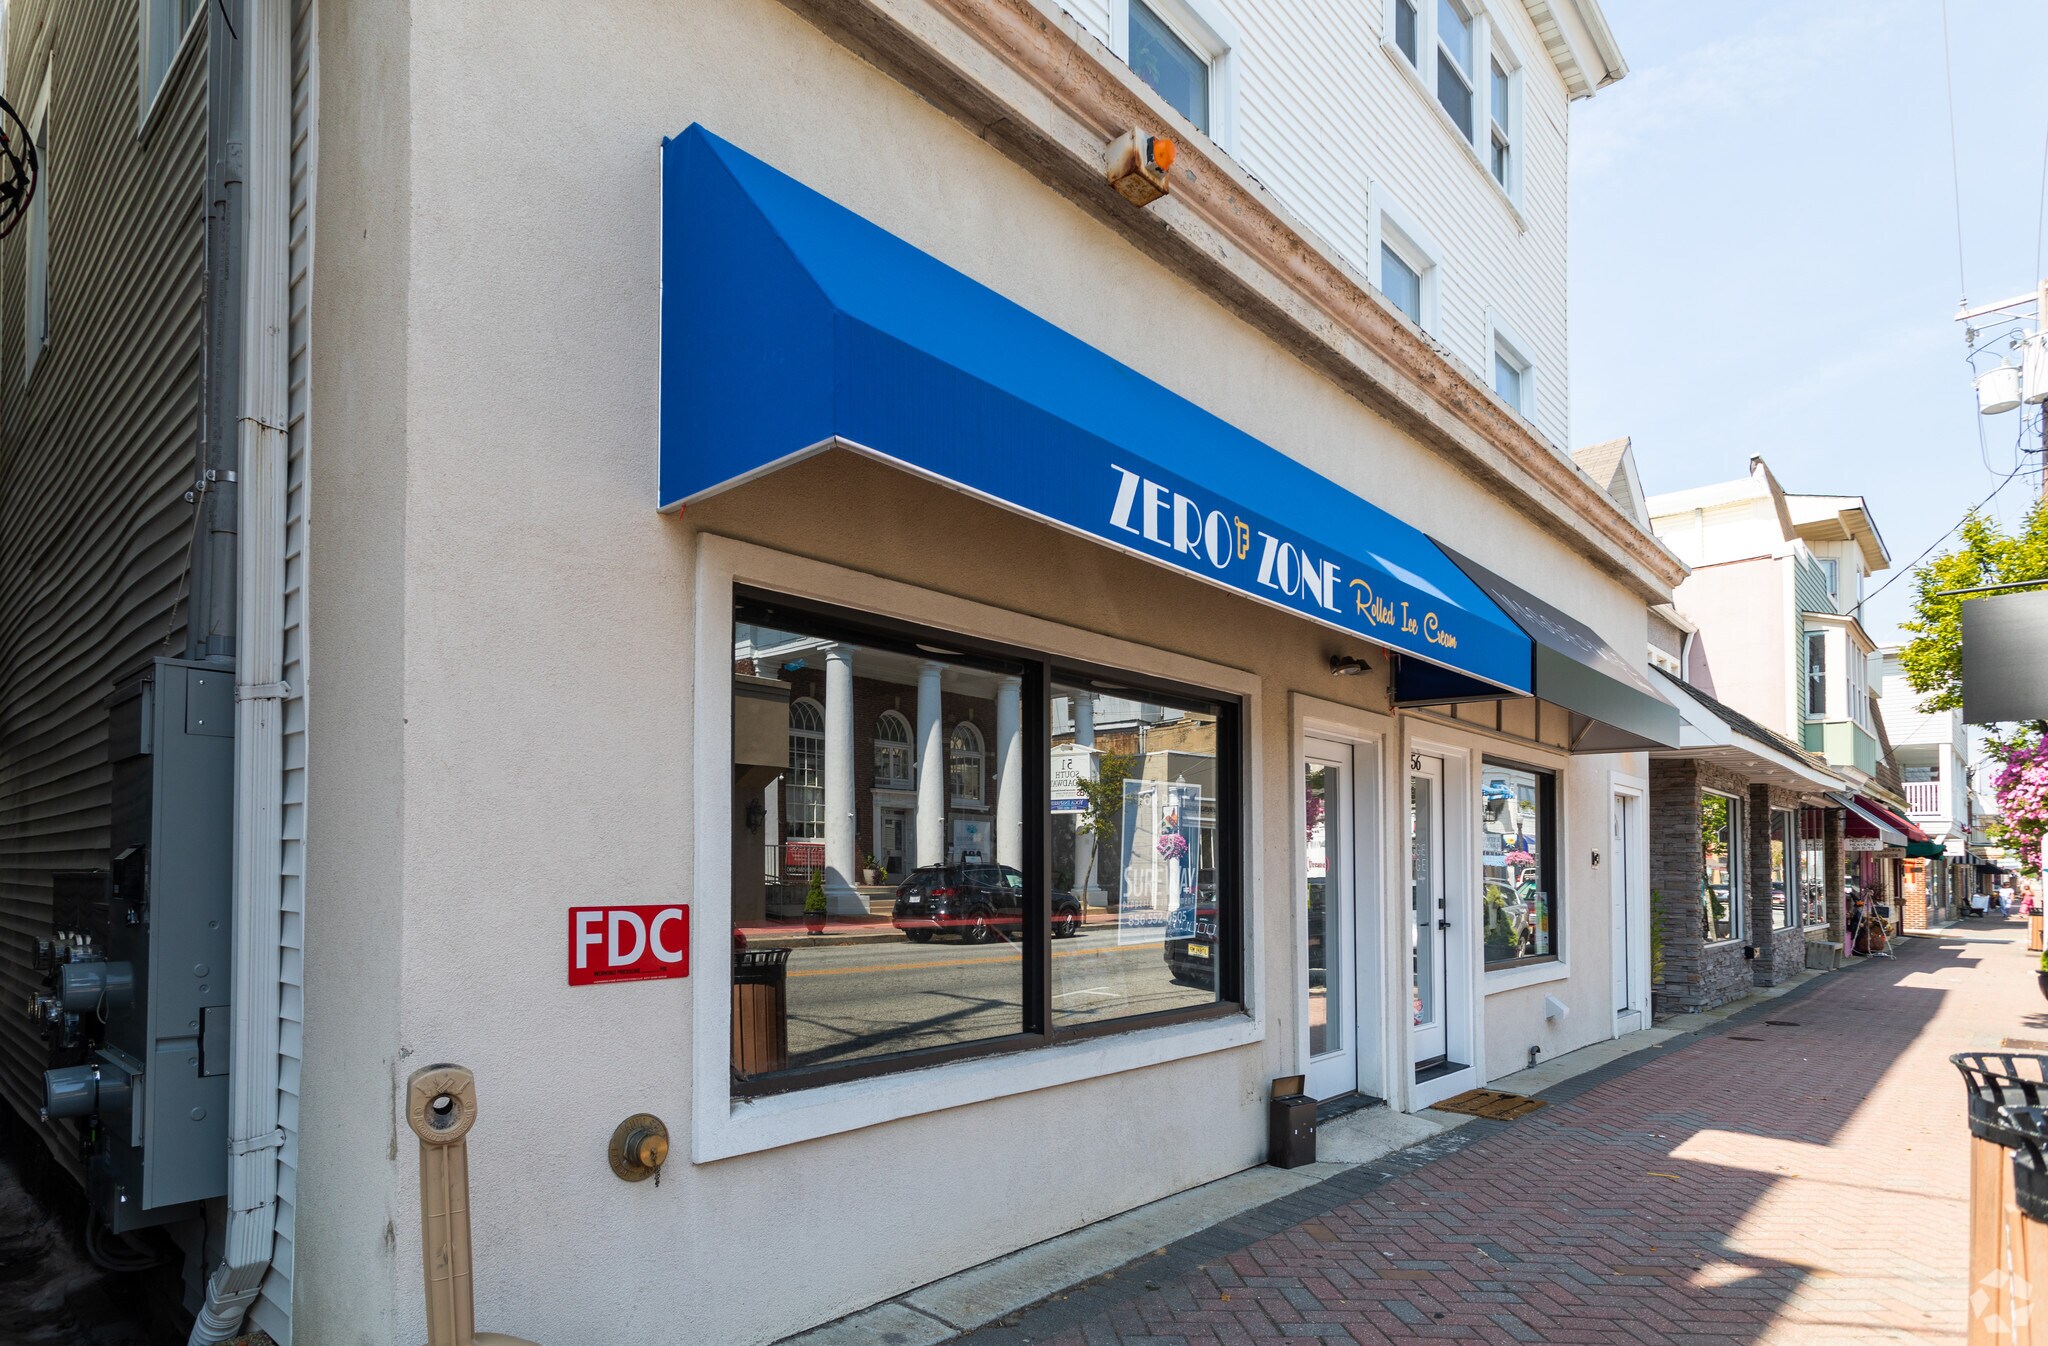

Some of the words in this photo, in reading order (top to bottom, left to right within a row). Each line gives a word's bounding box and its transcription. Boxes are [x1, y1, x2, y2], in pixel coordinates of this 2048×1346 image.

[1109, 463, 1232, 569] ZERO
[1257, 530, 1342, 613] ZONE
[1349, 578, 1396, 626] Rolled
[1400, 601, 1419, 635] Ice
[1423, 612, 1457, 649] Cream
[1410, 754, 1421, 771] 56
[576, 908, 683, 969] FDC
